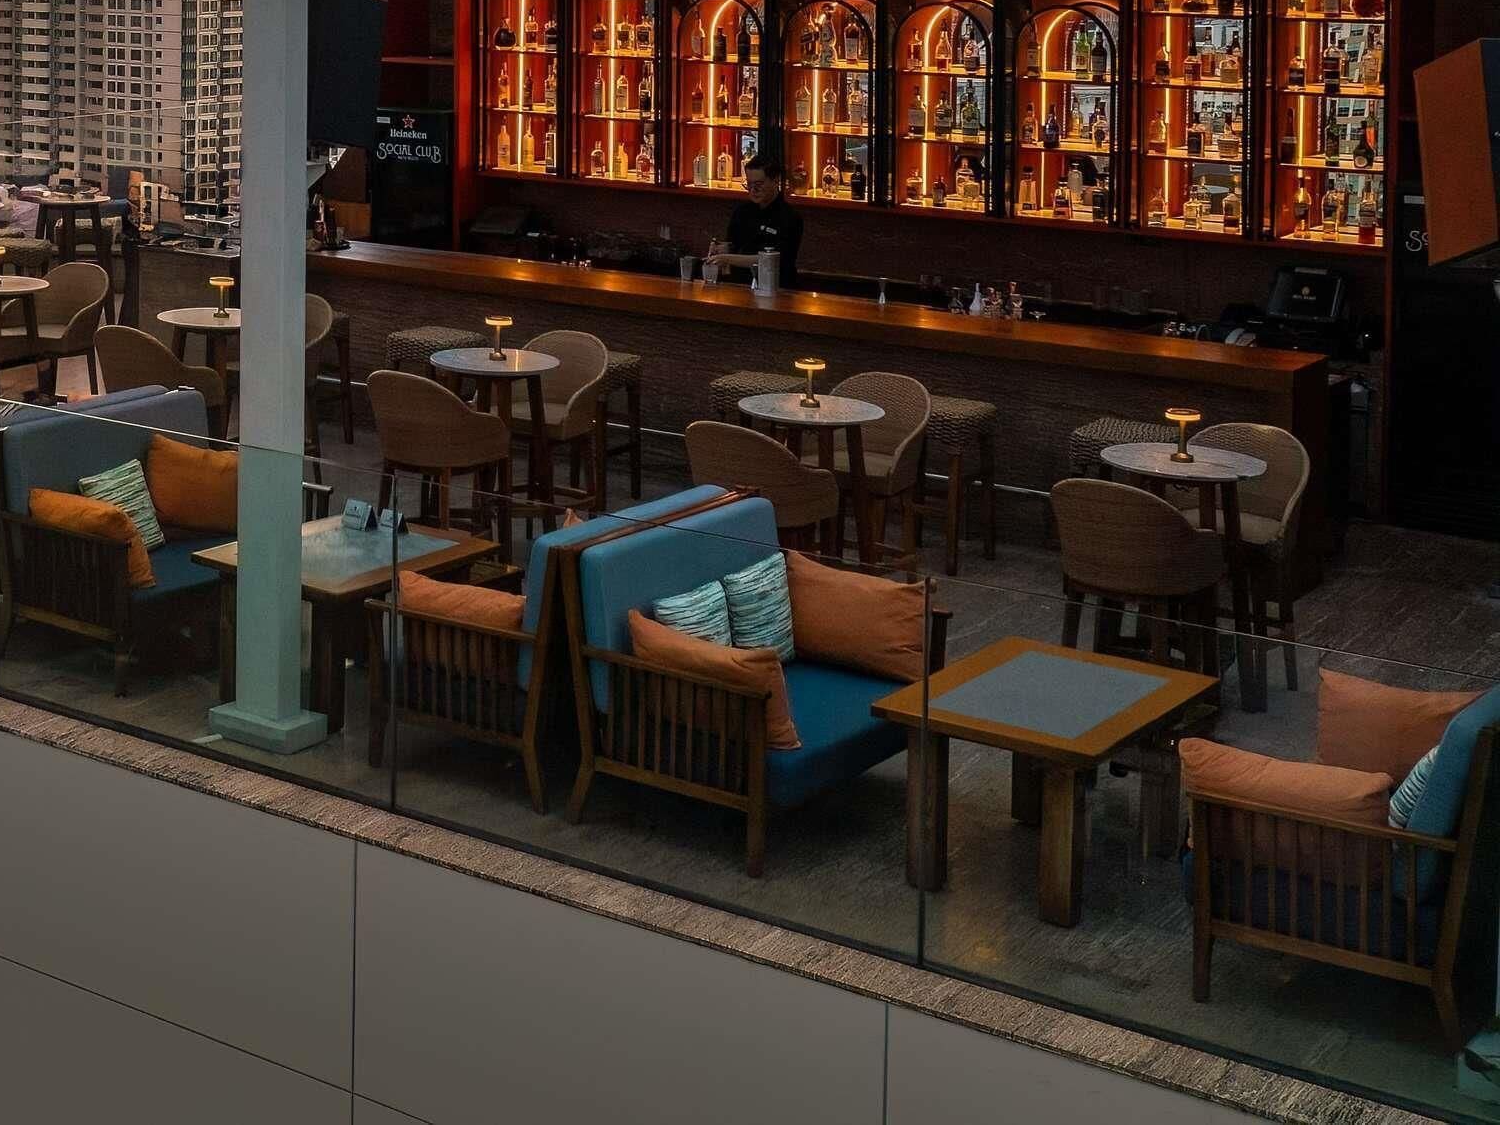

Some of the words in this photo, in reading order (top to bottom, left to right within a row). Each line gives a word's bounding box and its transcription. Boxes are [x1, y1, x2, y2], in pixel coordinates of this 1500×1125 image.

[390, 128, 427, 139] Heineken
[376, 142, 413, 160] SOCIAL
[415, 145, 442, 164] CLUB
